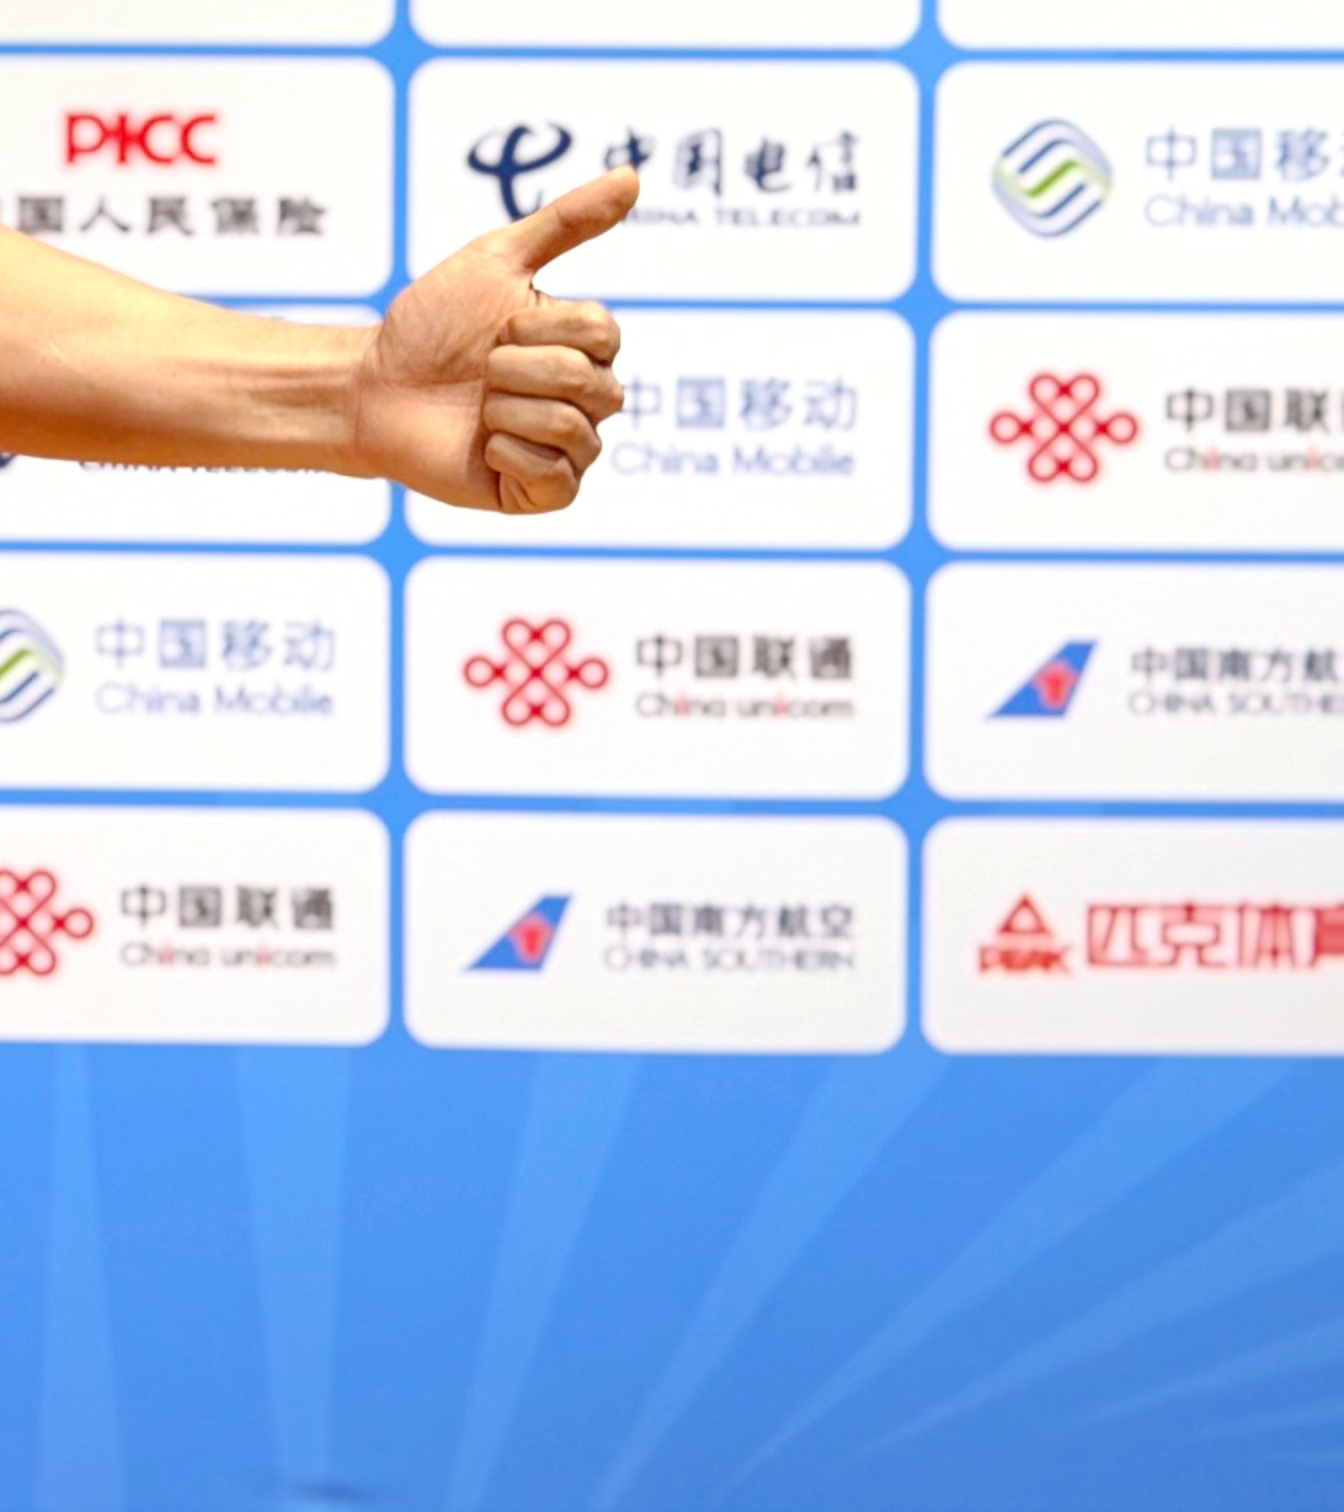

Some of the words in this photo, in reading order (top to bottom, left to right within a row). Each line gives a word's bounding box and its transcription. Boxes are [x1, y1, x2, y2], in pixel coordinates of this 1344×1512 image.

[61, 108, 221, 168] PICC
[1143, 125, 1344, 184] 中国移
[1142, 194, 1254, 228] China
[1165, 387, 1344, 434] 中国联
[610, 442, 719, 476] China
[733, 442, 853, 477] Mobile
[1163, 445, 1257, 473] China
[94, 615, 335, 674] 中国移动
[636, 633, 850, 681] 中国联通
[94, 681, 201, 715] China
[214, 682, 333, 716] Mobile
[634, 690, 726, 718] China
[120, 883, 332, 930] 中国联通
[605, 902, 852, 939] 中国南方航空
[120, 940, 210, 967] China
